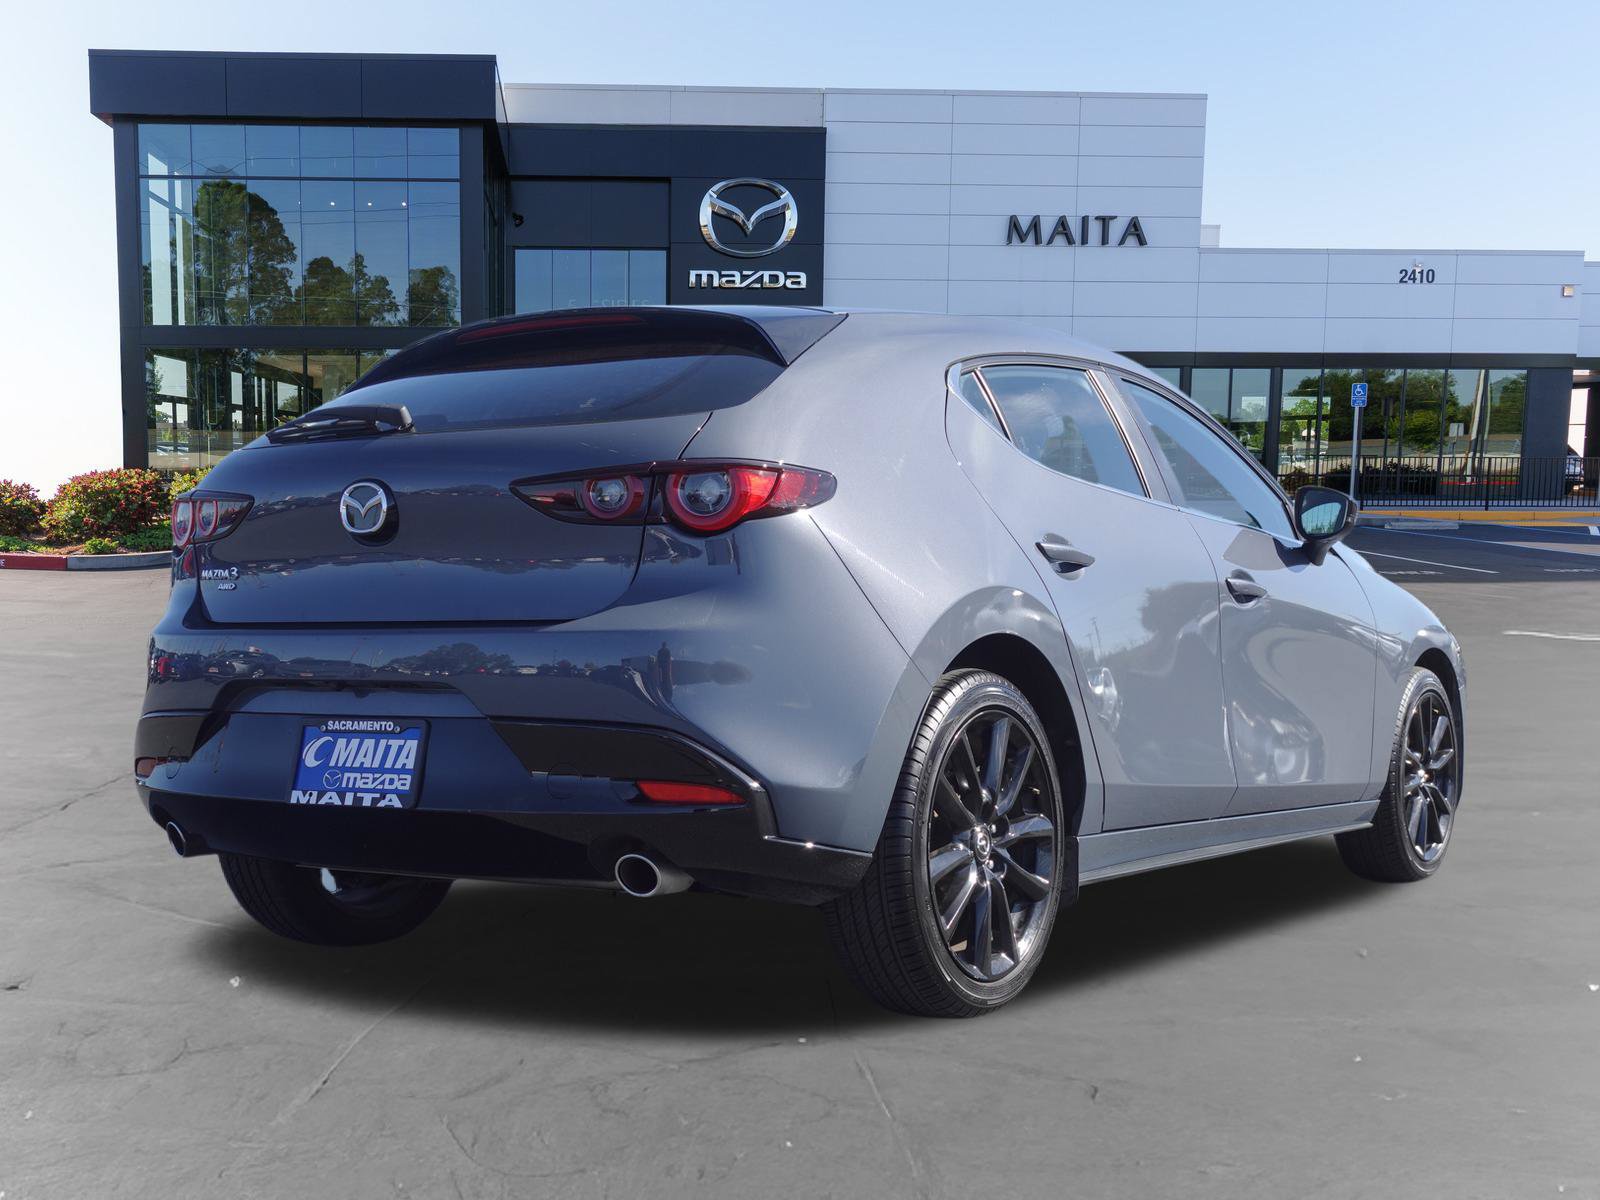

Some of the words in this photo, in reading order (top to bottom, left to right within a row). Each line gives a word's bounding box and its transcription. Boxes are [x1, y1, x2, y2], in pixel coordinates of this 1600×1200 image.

[1006, 214, 1148, 246] MAITA
[1398, 268, 1436, 284] 2410
[217, 583, 236, 591] AWD
[327, 720, 394, 731] SACRAMENTO
[290, 790, 403, 808] MAITA
